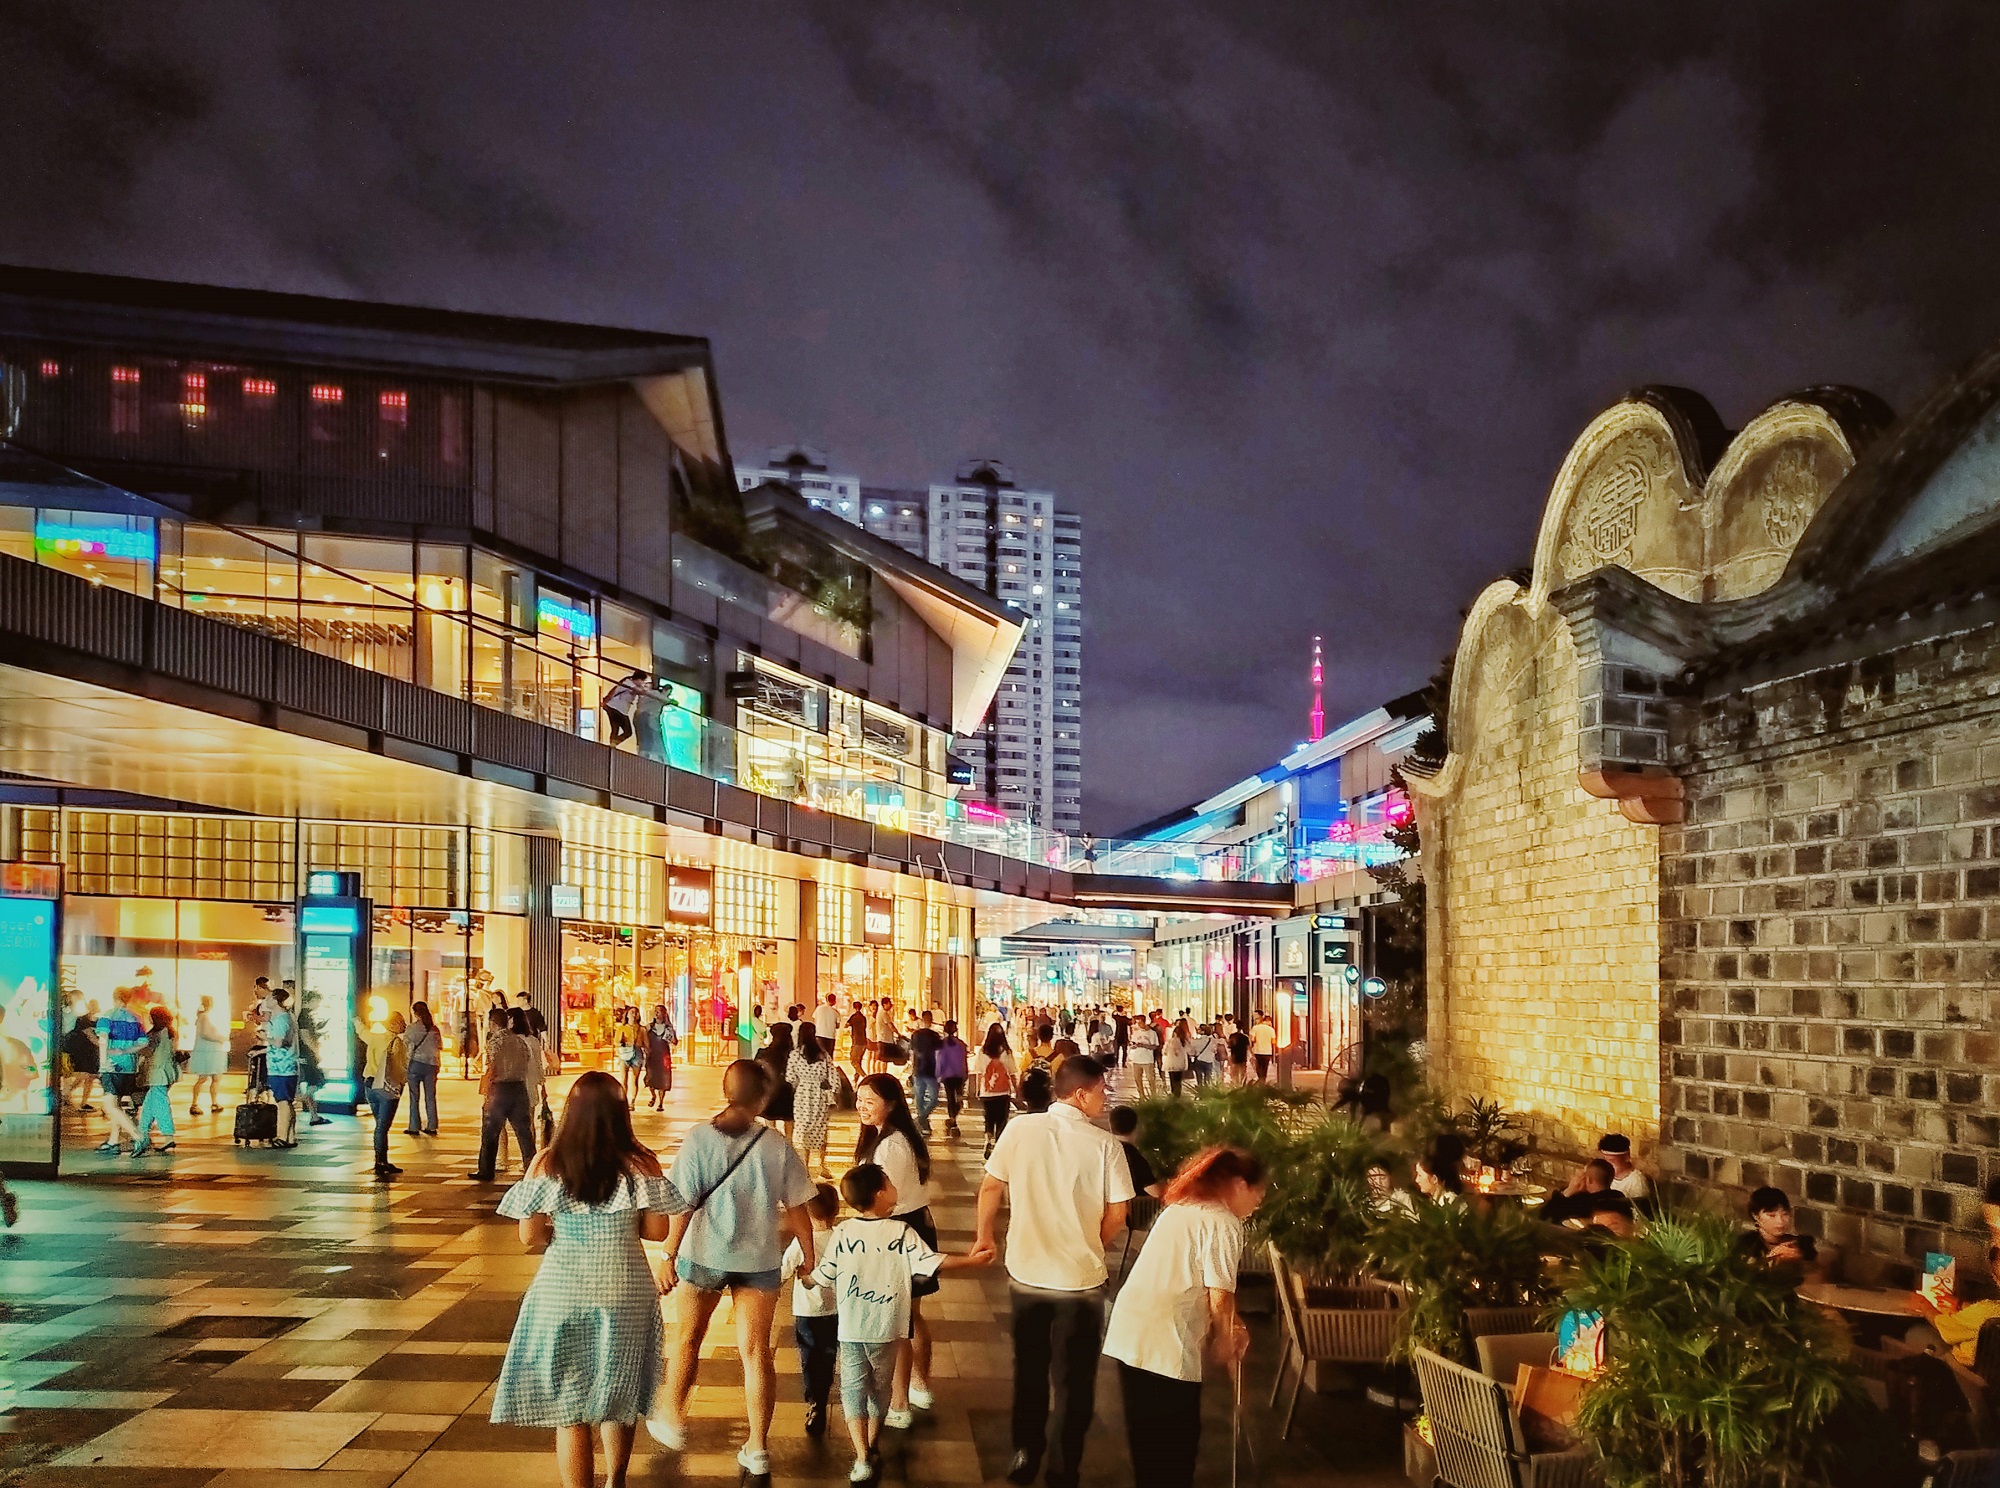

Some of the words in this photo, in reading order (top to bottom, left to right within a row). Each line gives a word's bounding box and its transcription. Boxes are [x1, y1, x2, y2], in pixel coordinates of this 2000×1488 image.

[109, 527, 147, 545] freh
[554, 892, 580, 908] izzue
[668, 877, 709, 914] izzue
[865, 905, 891, 935] izzue
